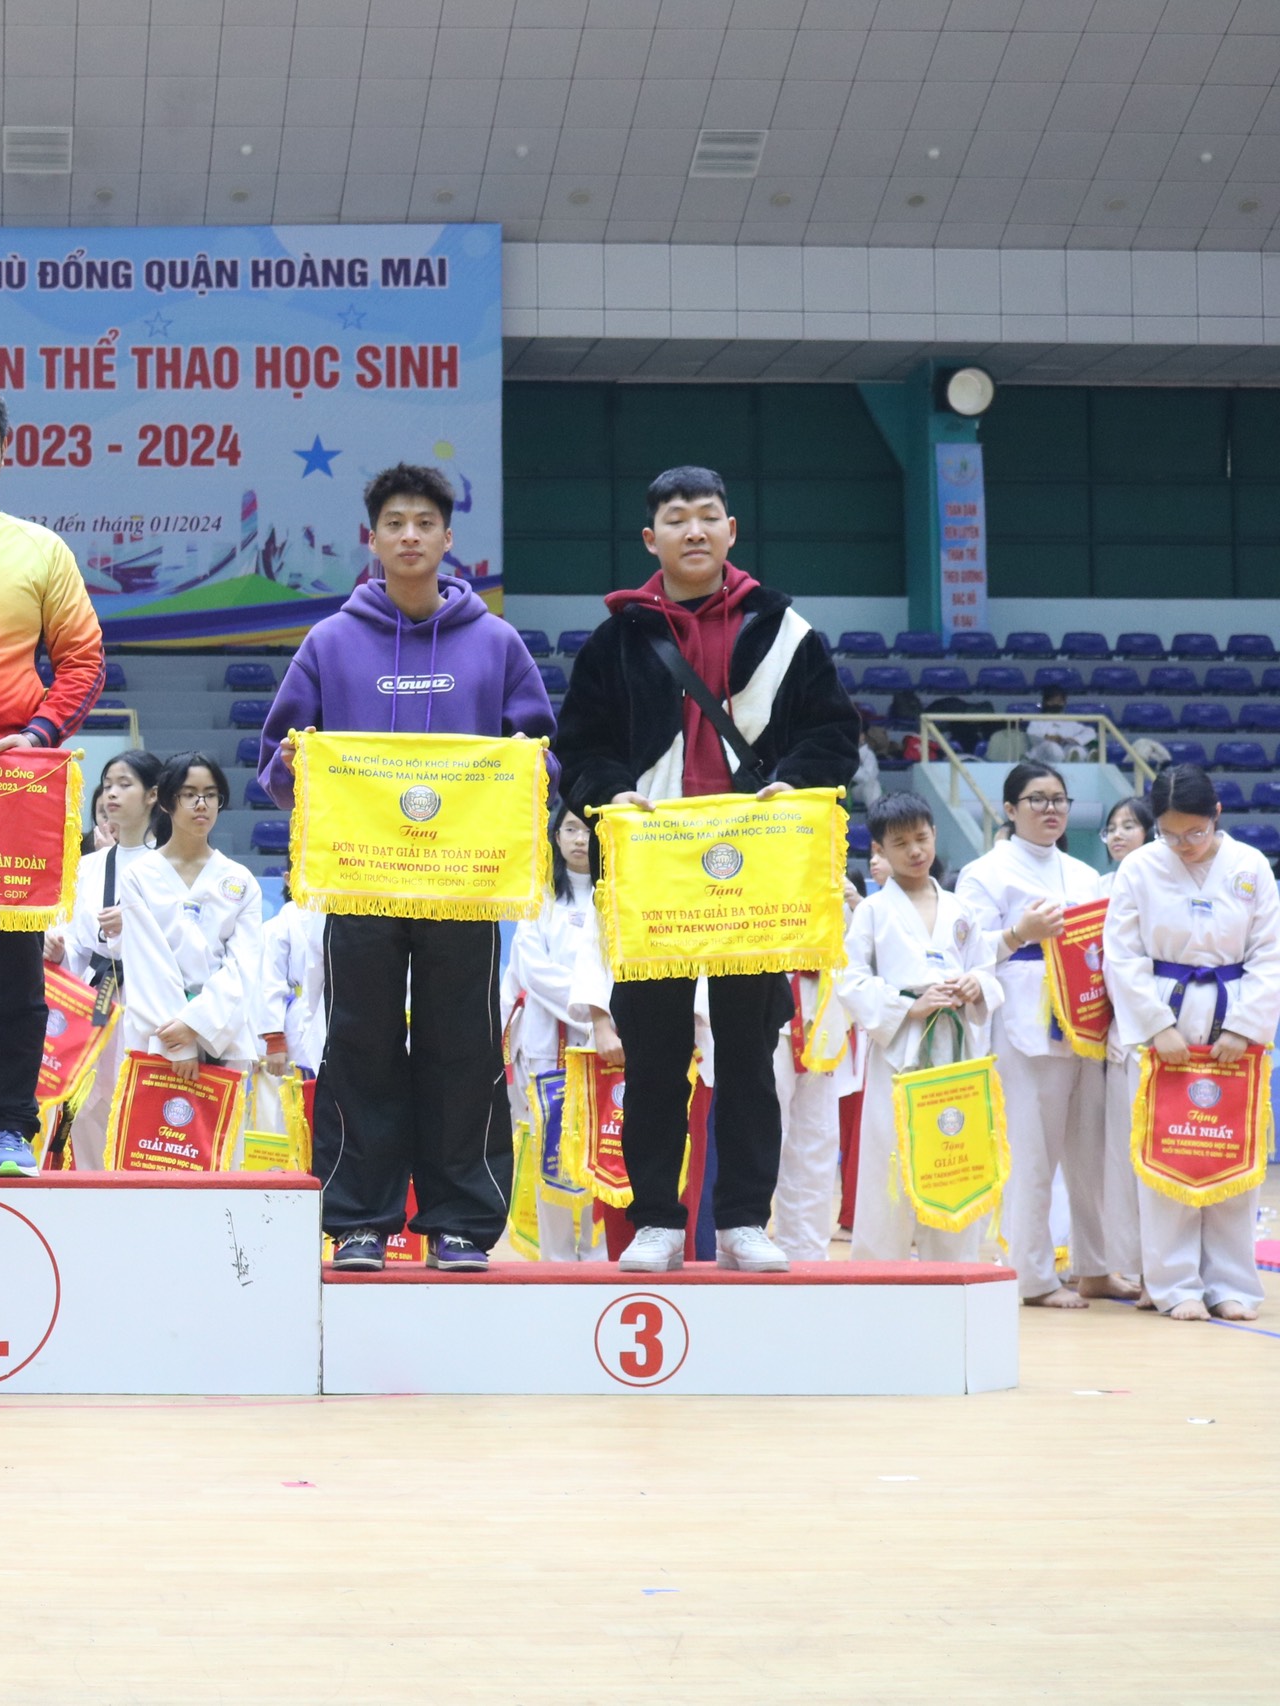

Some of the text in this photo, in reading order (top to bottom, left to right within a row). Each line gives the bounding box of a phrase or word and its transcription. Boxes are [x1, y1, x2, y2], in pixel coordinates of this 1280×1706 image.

[38, 249, 132, 290] ĐỔNG
[145, 254, 238, 295] QUẬN
[251, 253, 368, 288] HOÀNG
[381, 258, 447, 288] MAI
[39, 329, 120, 389] THỂ
[131, 346, 239, 389] THAO
[255, 346, 340, 398] HỌC
[355, 345, 458, 389] SINH
[108, 445, 122, 453] -
[137, 424, 241, 466] 2024
[54, 513, 85, 532] đến
[93, 515, 144, 535] tháng
[150, 515, 222, 532] 01/2024
[5, 767, 34, 779] ĐỔNG
[358, 768, 393, 778] HOÀNG
[416, 771, 438, 780] NĂM
[441, 773, 462, 782] HỌC
[465, 773, 485, 781] 2023
[494, 773, 514, 781] 2024
[26, 784, 47, 793] 2024
[399, 825, 437, 840] Tặng
[332, 841, 355, 852] ĐƠN
[396, 843, 420, 857] GIẢI
[423, 849, 437, 858] BA
[441, 847, 471, 859] TOÀN
[475, 847, 506, 859] ĐOÀN
[14, 855, 46, 870] ĐOÀN
[339, 856, 499, 875] MÔN TAEKWONDO HỌC SINH
[3, 875, 31, 885] SINH
[4, 890, 28, 899] GDTX
[704, 885, 743, 899] Tặng
[642, 910, 663, 920] ĐƠN
[703, 904, 727, 918] GIẢI
[731, 907, 745, 916] BA
[749, 902, 778, 915] TOÀN
[782, 901, 811, 913] ĐOÀN
[648, 924, 673, 934] MÔN
[676, 921, 749, 932] TAEKWONDO
[753, 920, 776, 931] HỌC
[1187, 1109, 1218, 1123] Tặng
[158, 1125, 186, 1141] Tặng
[1168, 1122, 1233, 1139] GIẢI NHẤT
[138, 1138, 199, 1159] GIẢI NHẤT
[620, 1302, 664, 1378] 3
